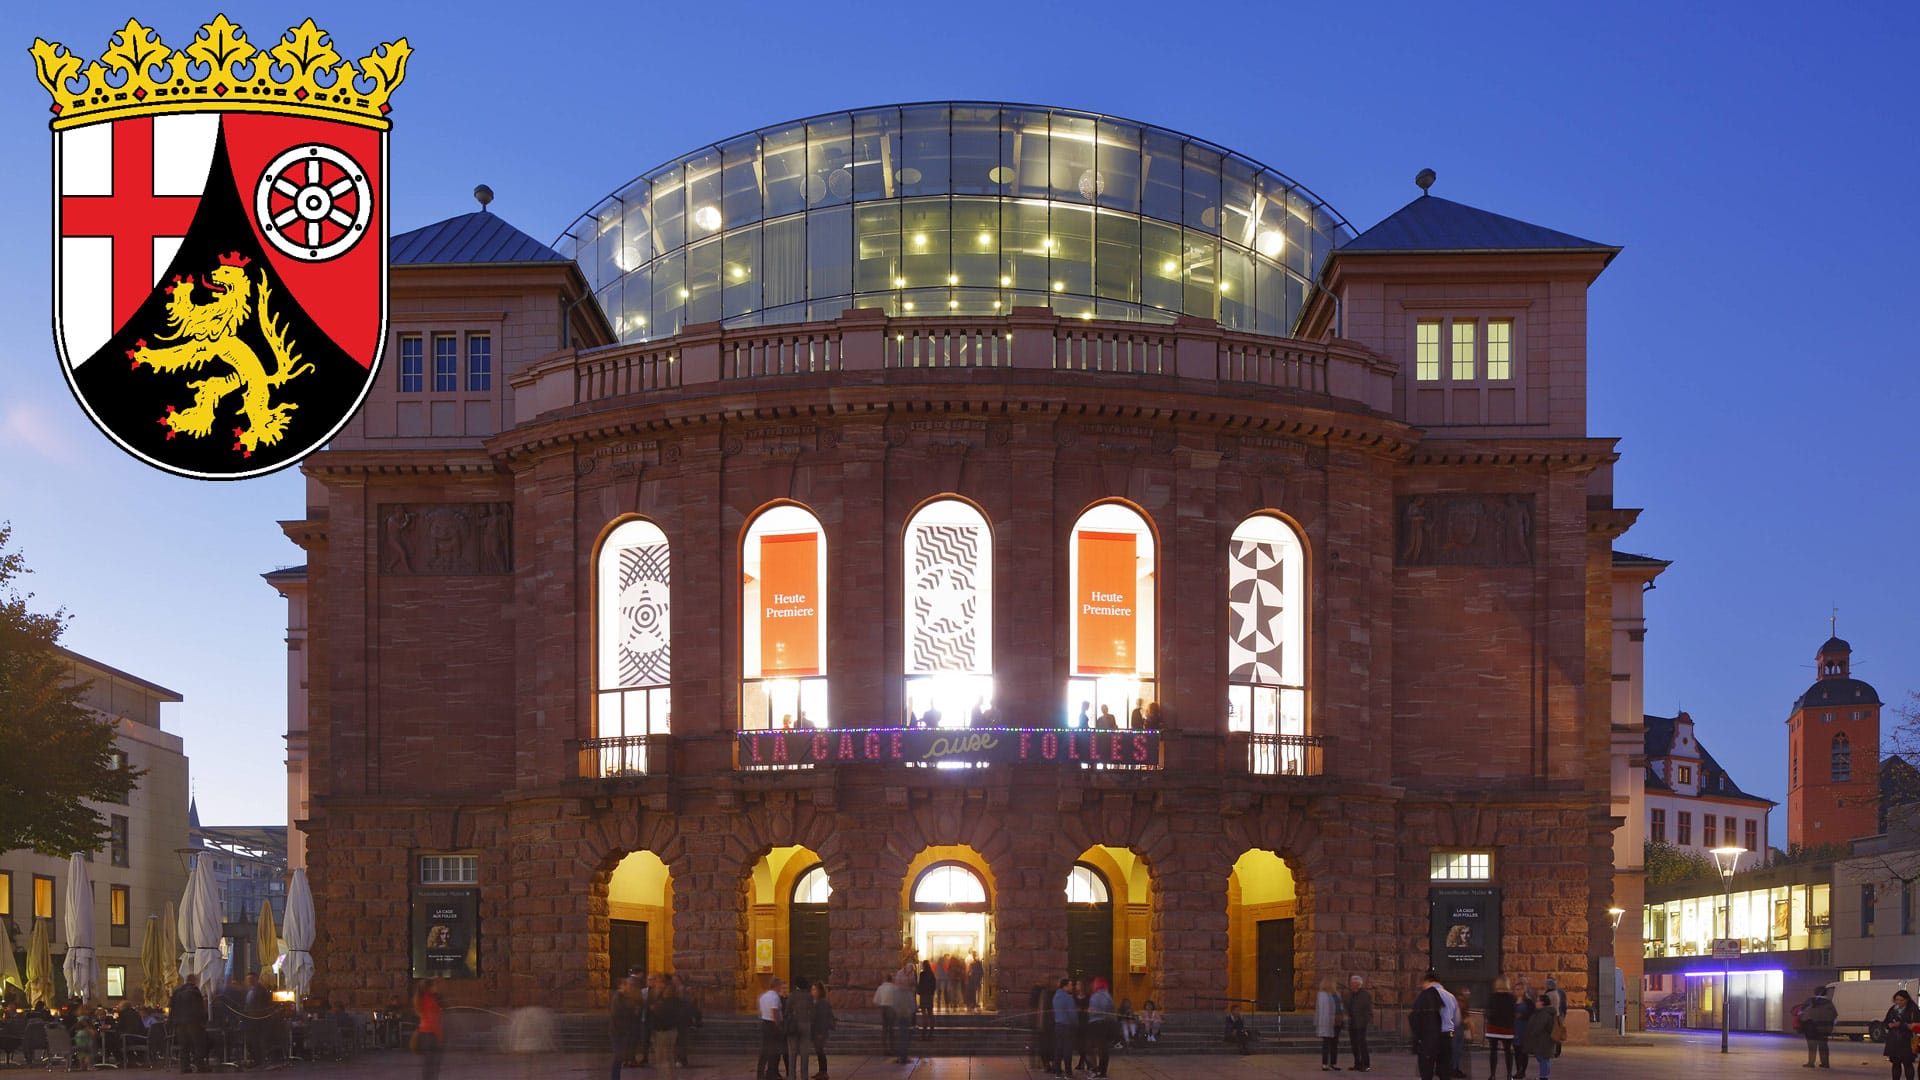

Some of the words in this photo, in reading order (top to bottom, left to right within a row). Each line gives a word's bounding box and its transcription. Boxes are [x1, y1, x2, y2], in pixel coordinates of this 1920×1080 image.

[774, 594, 806, 604] Heute
[1091, 591, 1123, 603] Heute
[766, 605, 814, 618] Premiere
[1083, 604, 1132, 616] Premiere
[751, 734, 788, 762] LA
[812, 732, 903, 760] CAGE
[1018, 732, 1148, 760] FOLLES
